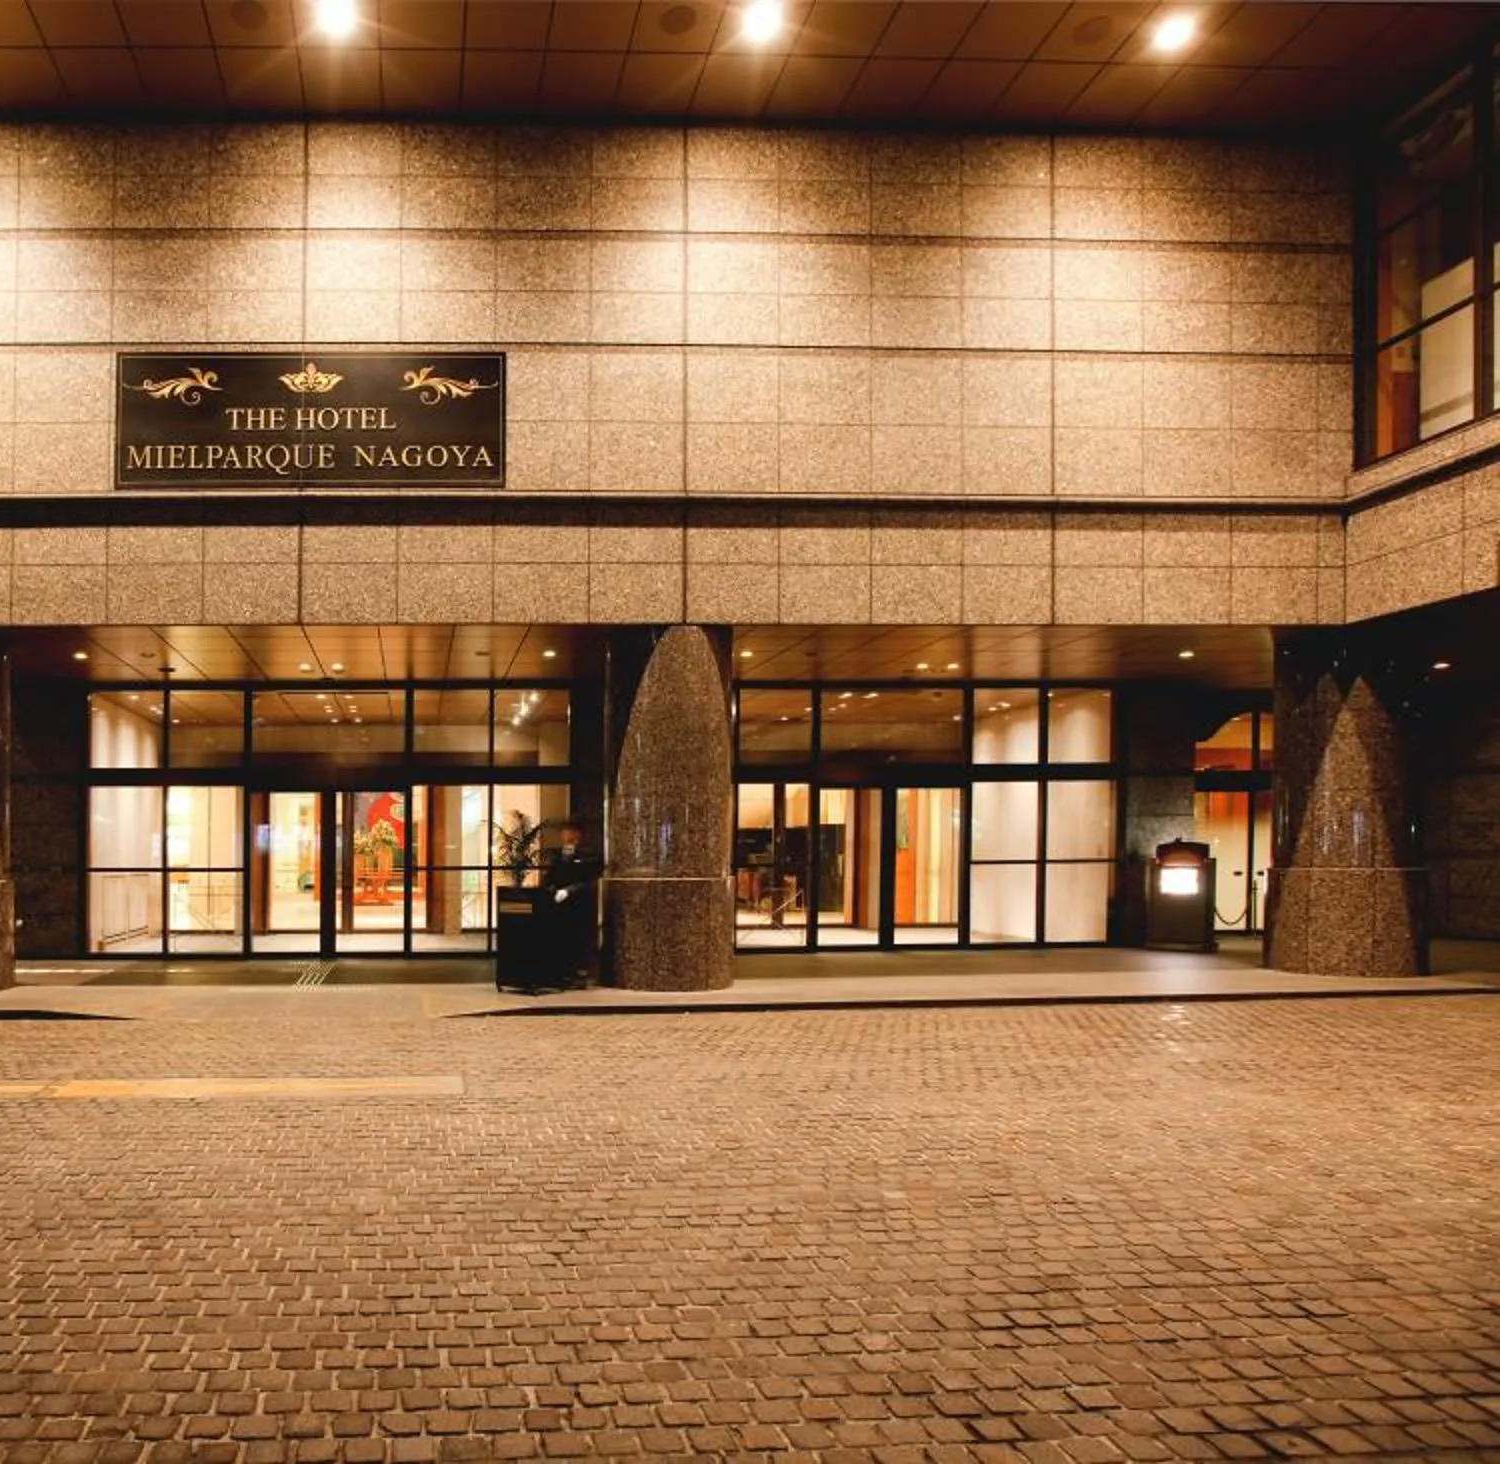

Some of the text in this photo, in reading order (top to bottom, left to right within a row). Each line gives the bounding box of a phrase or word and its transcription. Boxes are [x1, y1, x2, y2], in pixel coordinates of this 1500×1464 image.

[226, 407, 397, 432] THE HOTEL
[126, 445, 495, 475] MIELPARQUE NAGOYA
